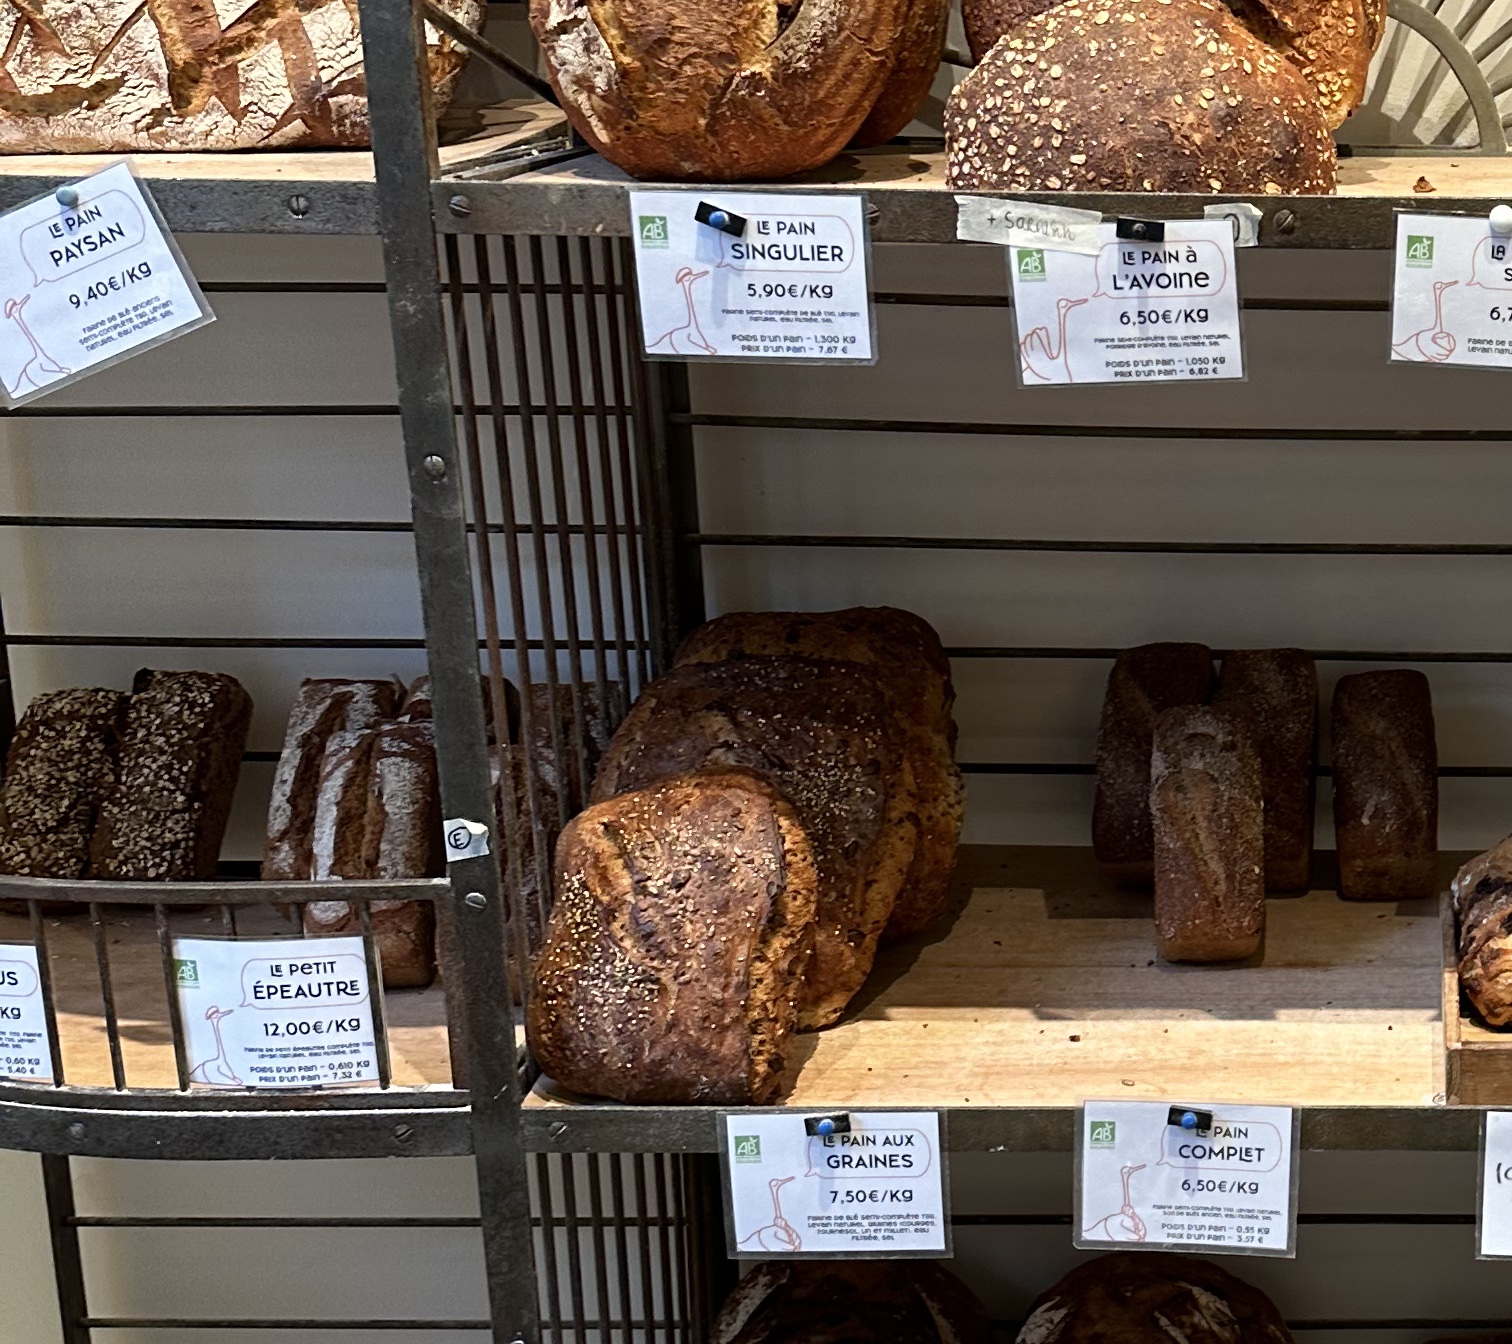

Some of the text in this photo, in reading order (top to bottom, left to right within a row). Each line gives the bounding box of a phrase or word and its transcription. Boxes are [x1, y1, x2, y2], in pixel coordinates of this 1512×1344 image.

[48, 205, 103, 239] LE PAIN
[757, 220, 815, 235] LE PAIN
[49, 222, 126, 268] PAYSAN
[731, 243, 844, 262] SINGULIER
[1491, 244, 1505, 261] LA
[1122, 245, 1197, 266] LE PAIN à
[69, 261, 152, 310] 9,40€/Kg
[747, 284, 834, 299] 5,90€/Kg
[1120, 308, 1209, 325] 6,50€/Kg
[270, 964, 283, 977] LE
[253, 979, 360, 1000] ÉPEAUTRE
[263, 1017, 361, 1036] 12,00€/Kg
[823, 1134, 914, 1147] LE PAIN AUX
[1213, 1126, 1249, 1139] PAIN
[827, 1154, 914, 1169] GRAINES
[1178, 1144, 1265, 1163] COMPLET
[1181, 1179, 1259, 1194] 6,50€/Kg
[830, 1189, 914, 1204] 7,50€/Kg
